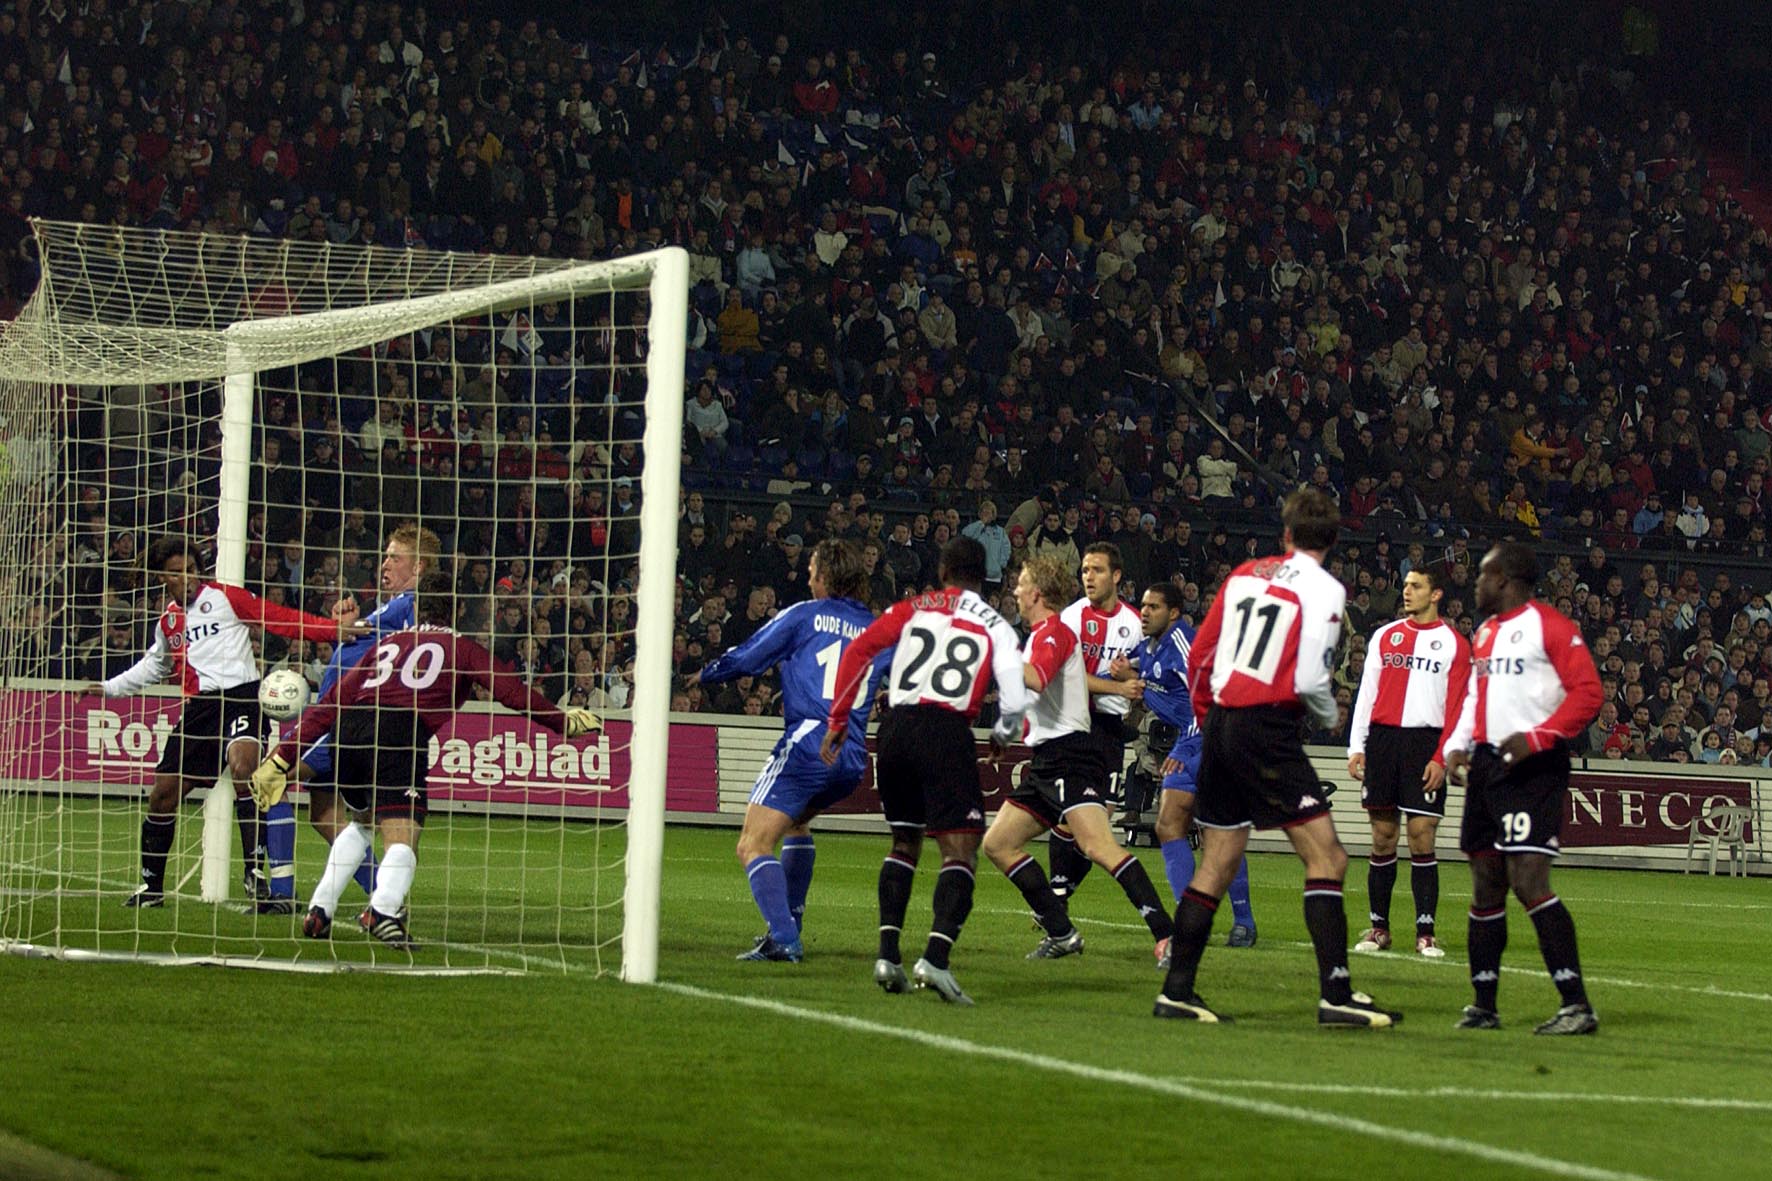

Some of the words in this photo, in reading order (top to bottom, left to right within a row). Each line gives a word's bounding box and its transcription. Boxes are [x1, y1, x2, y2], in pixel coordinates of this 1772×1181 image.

[813, 614, 841, 636] OUDE
[1232, 596, 1282, 671] 11
[362, 642, 446, 690] 30
[898, 626, 980, 699] 28
[1382, 654, 1442, 674] FORTIS
[230, 715, 250, 737] 15
[1501, 812, 1532, 843] 19
